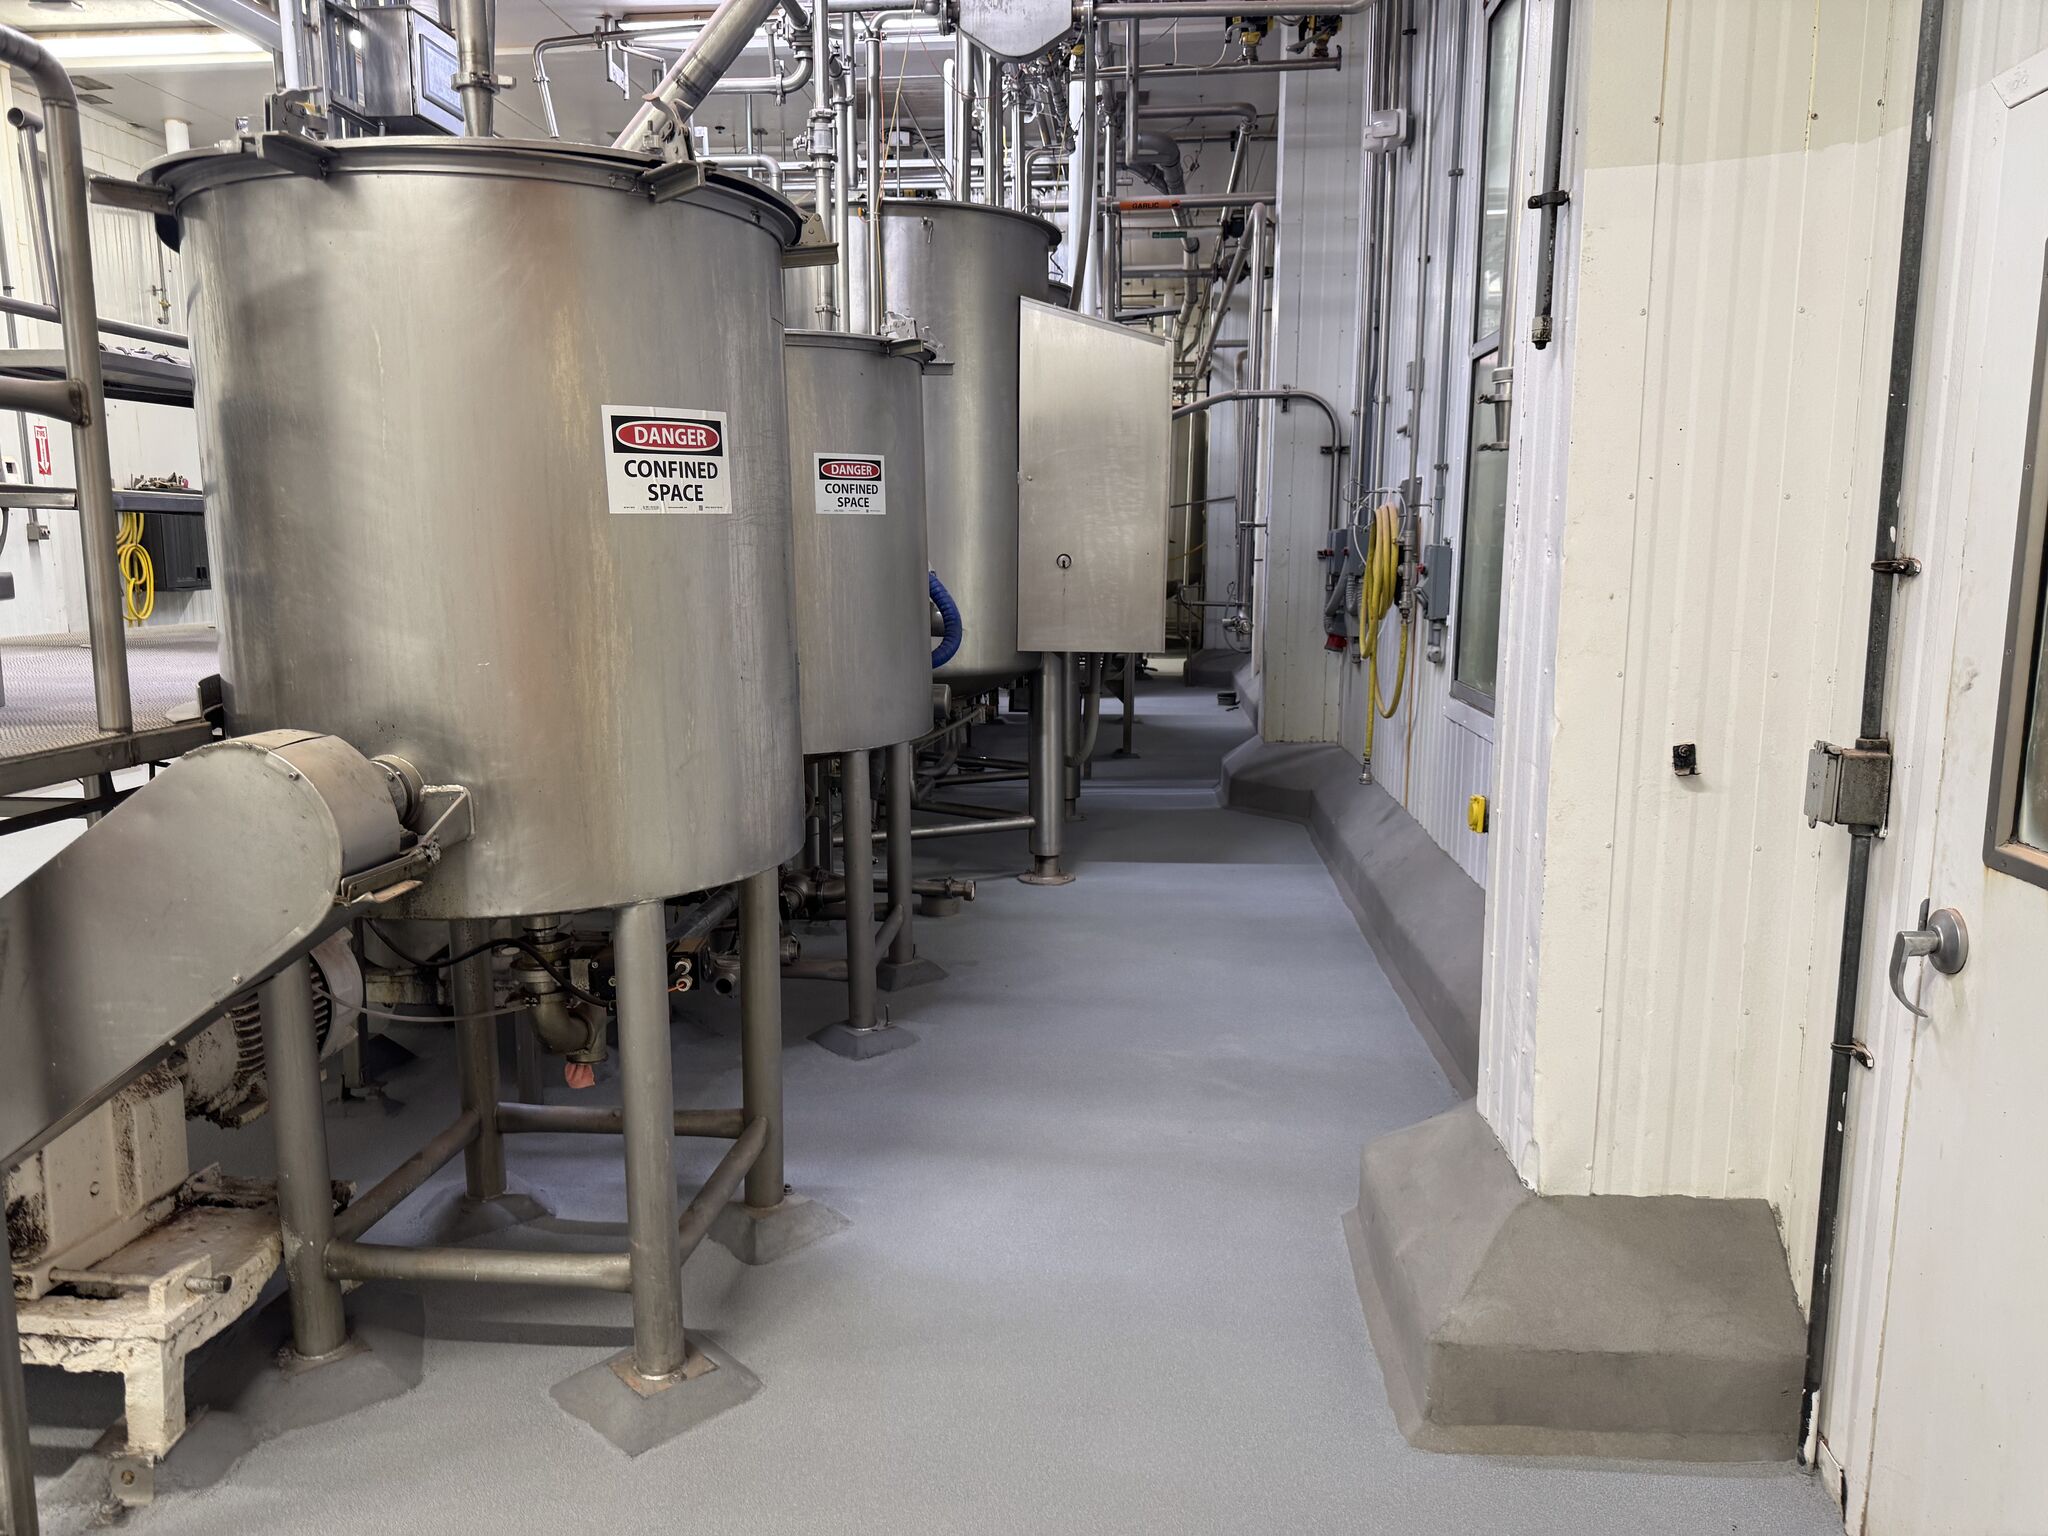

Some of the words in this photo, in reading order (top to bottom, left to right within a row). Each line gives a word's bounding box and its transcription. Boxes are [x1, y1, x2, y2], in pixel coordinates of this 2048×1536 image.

[634, 426, 707, 446] DANGER
[624, 460, 718, 479] CONFINED
[831, 464, 873, 476] DANGER
[647, 484, 704, 501] SPACE
[825, 483, 879, 495] CONFINED
[837, 497, 870, 508] SPACE
